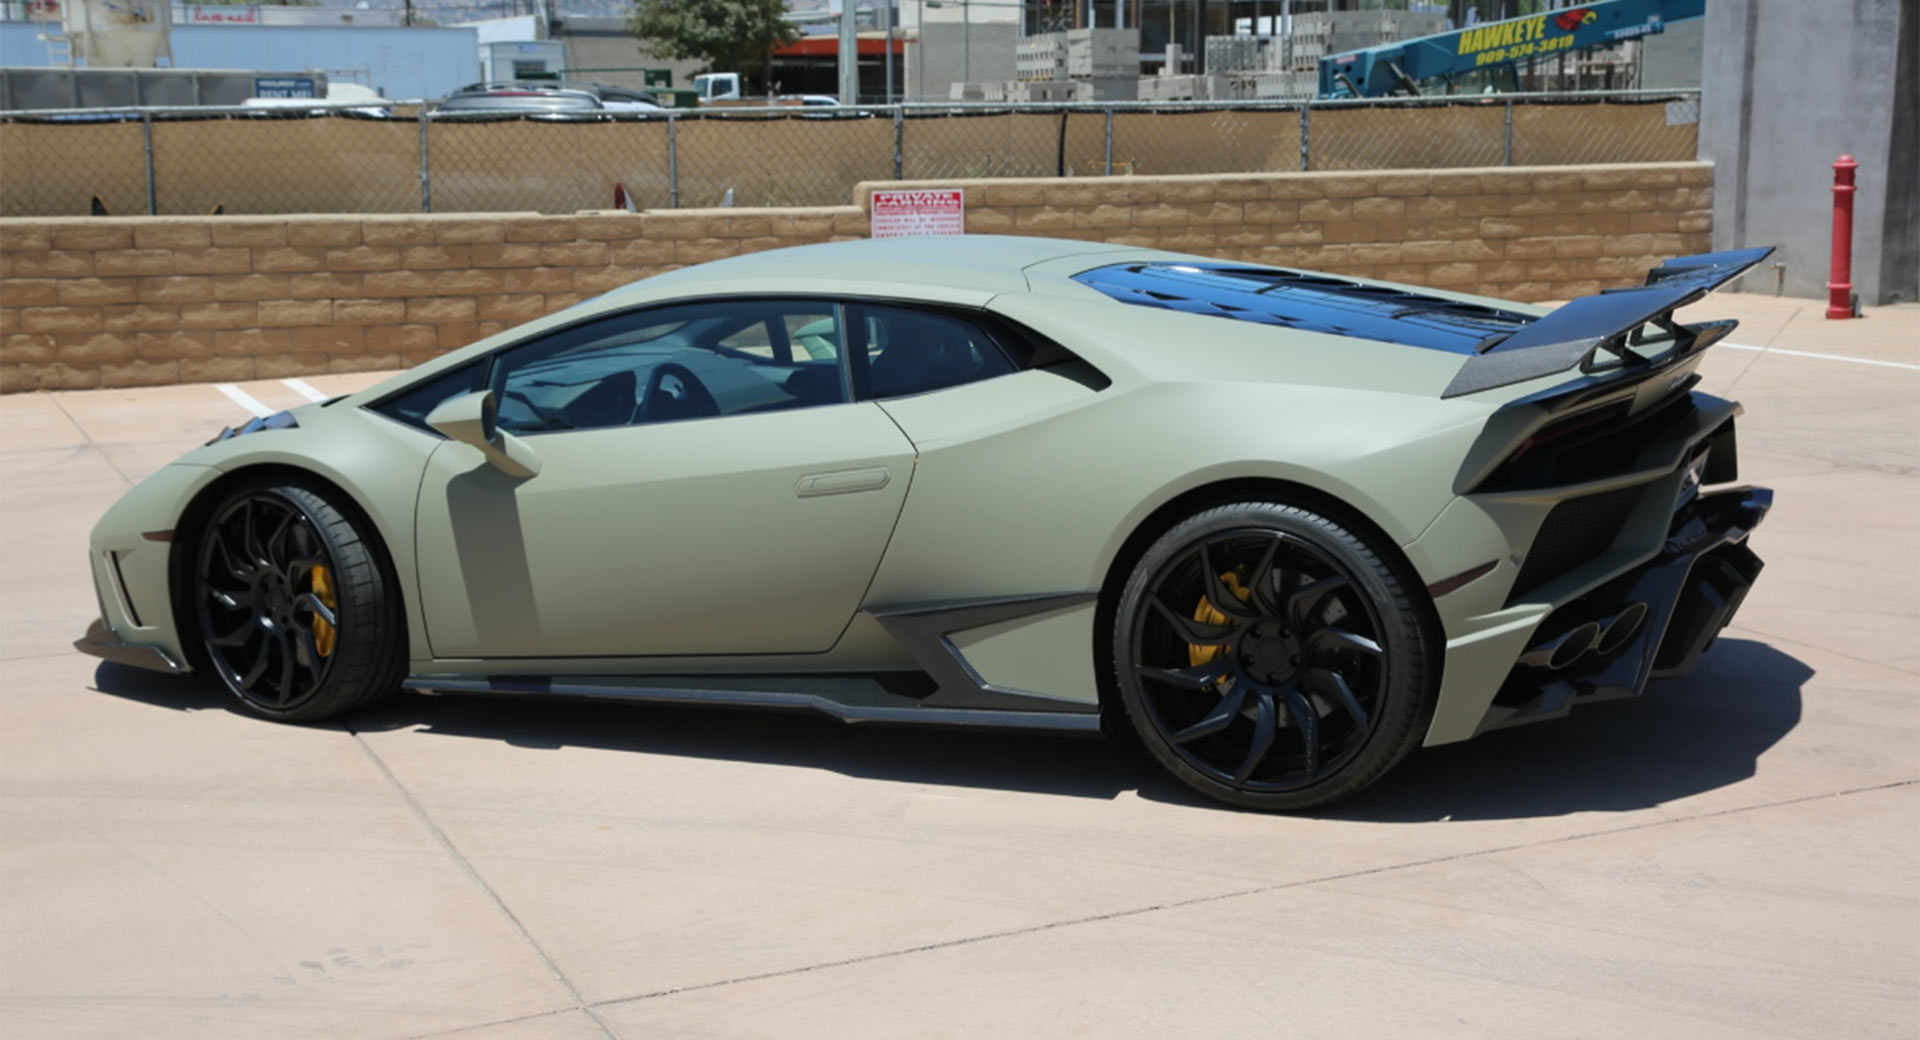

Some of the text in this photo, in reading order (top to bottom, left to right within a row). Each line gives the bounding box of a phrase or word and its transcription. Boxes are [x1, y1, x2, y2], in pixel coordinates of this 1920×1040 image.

[1458, 15, 1547, 55] HAWKEYE
[1475, 34, 1575, 66] 909-574-3819
[875, 199, 960, 208] PARKING
[879, 192, 954, 202] PRIVATE
